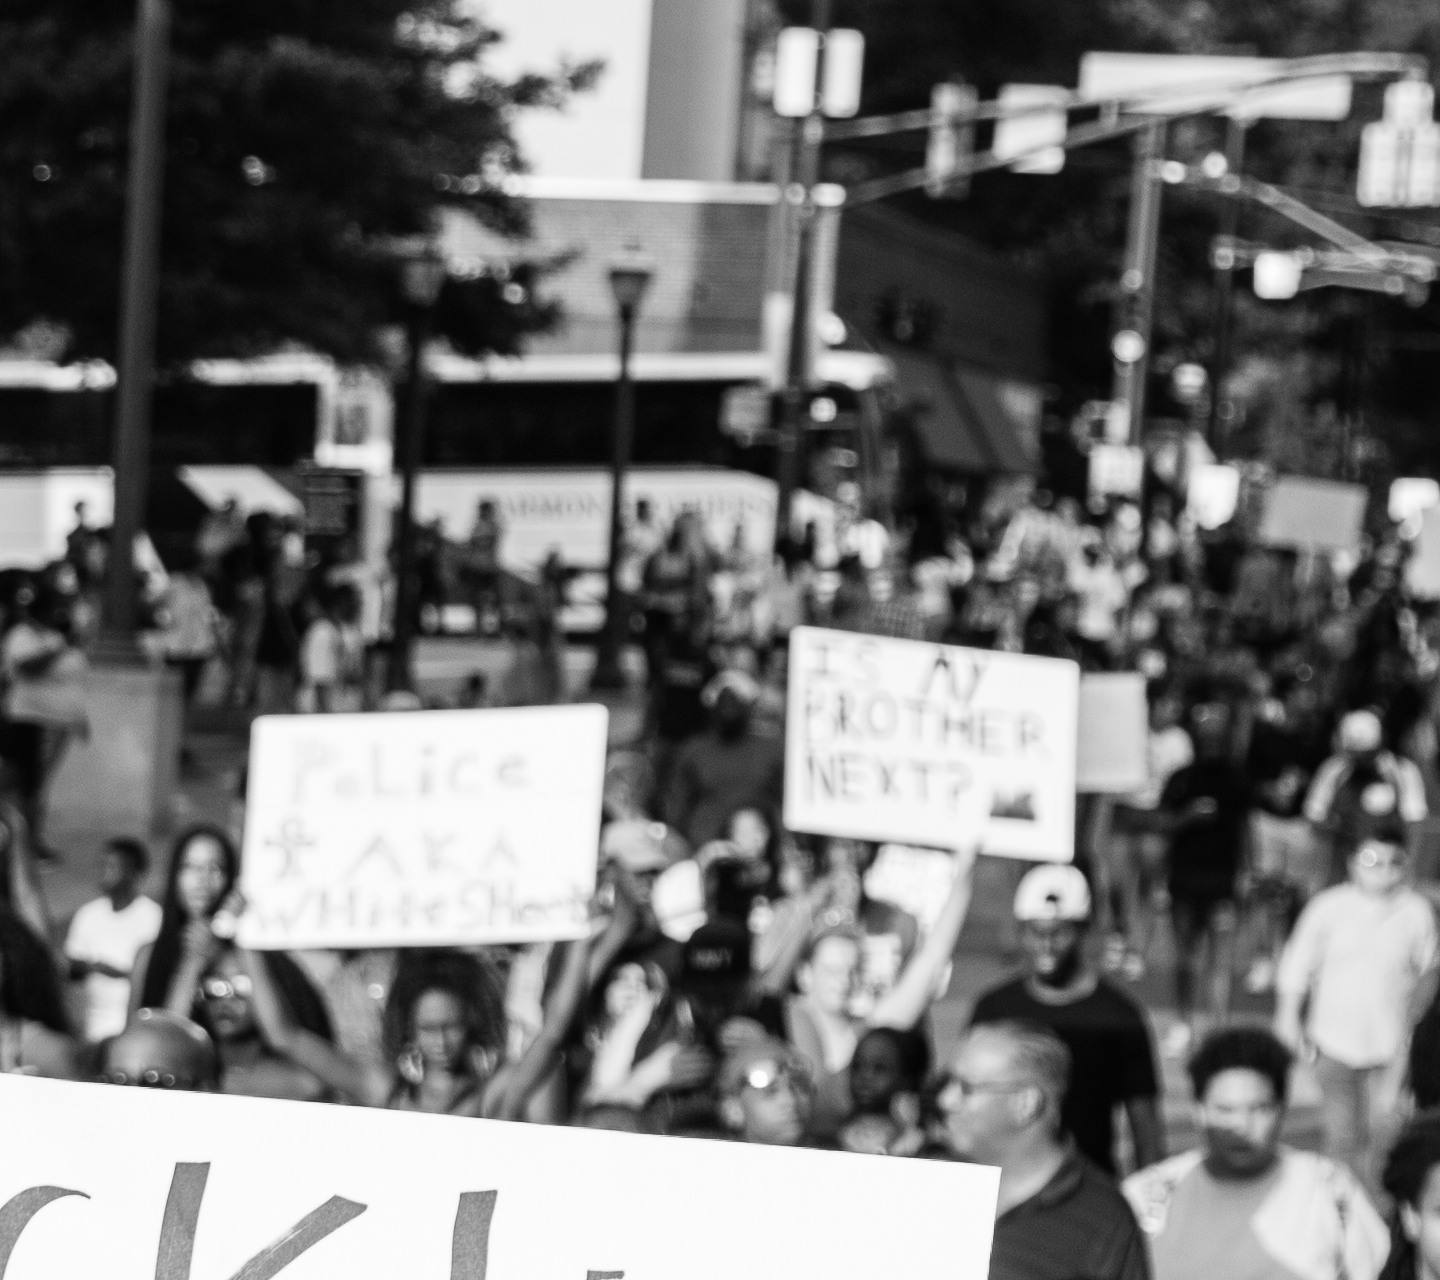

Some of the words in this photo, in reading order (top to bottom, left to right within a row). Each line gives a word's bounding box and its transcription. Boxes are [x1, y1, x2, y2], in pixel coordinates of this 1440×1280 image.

[804, 640, 883, 688] IS
[804, 687, 1052, 763] BROTHER
[804, 752, 975, 817] NEXT?
